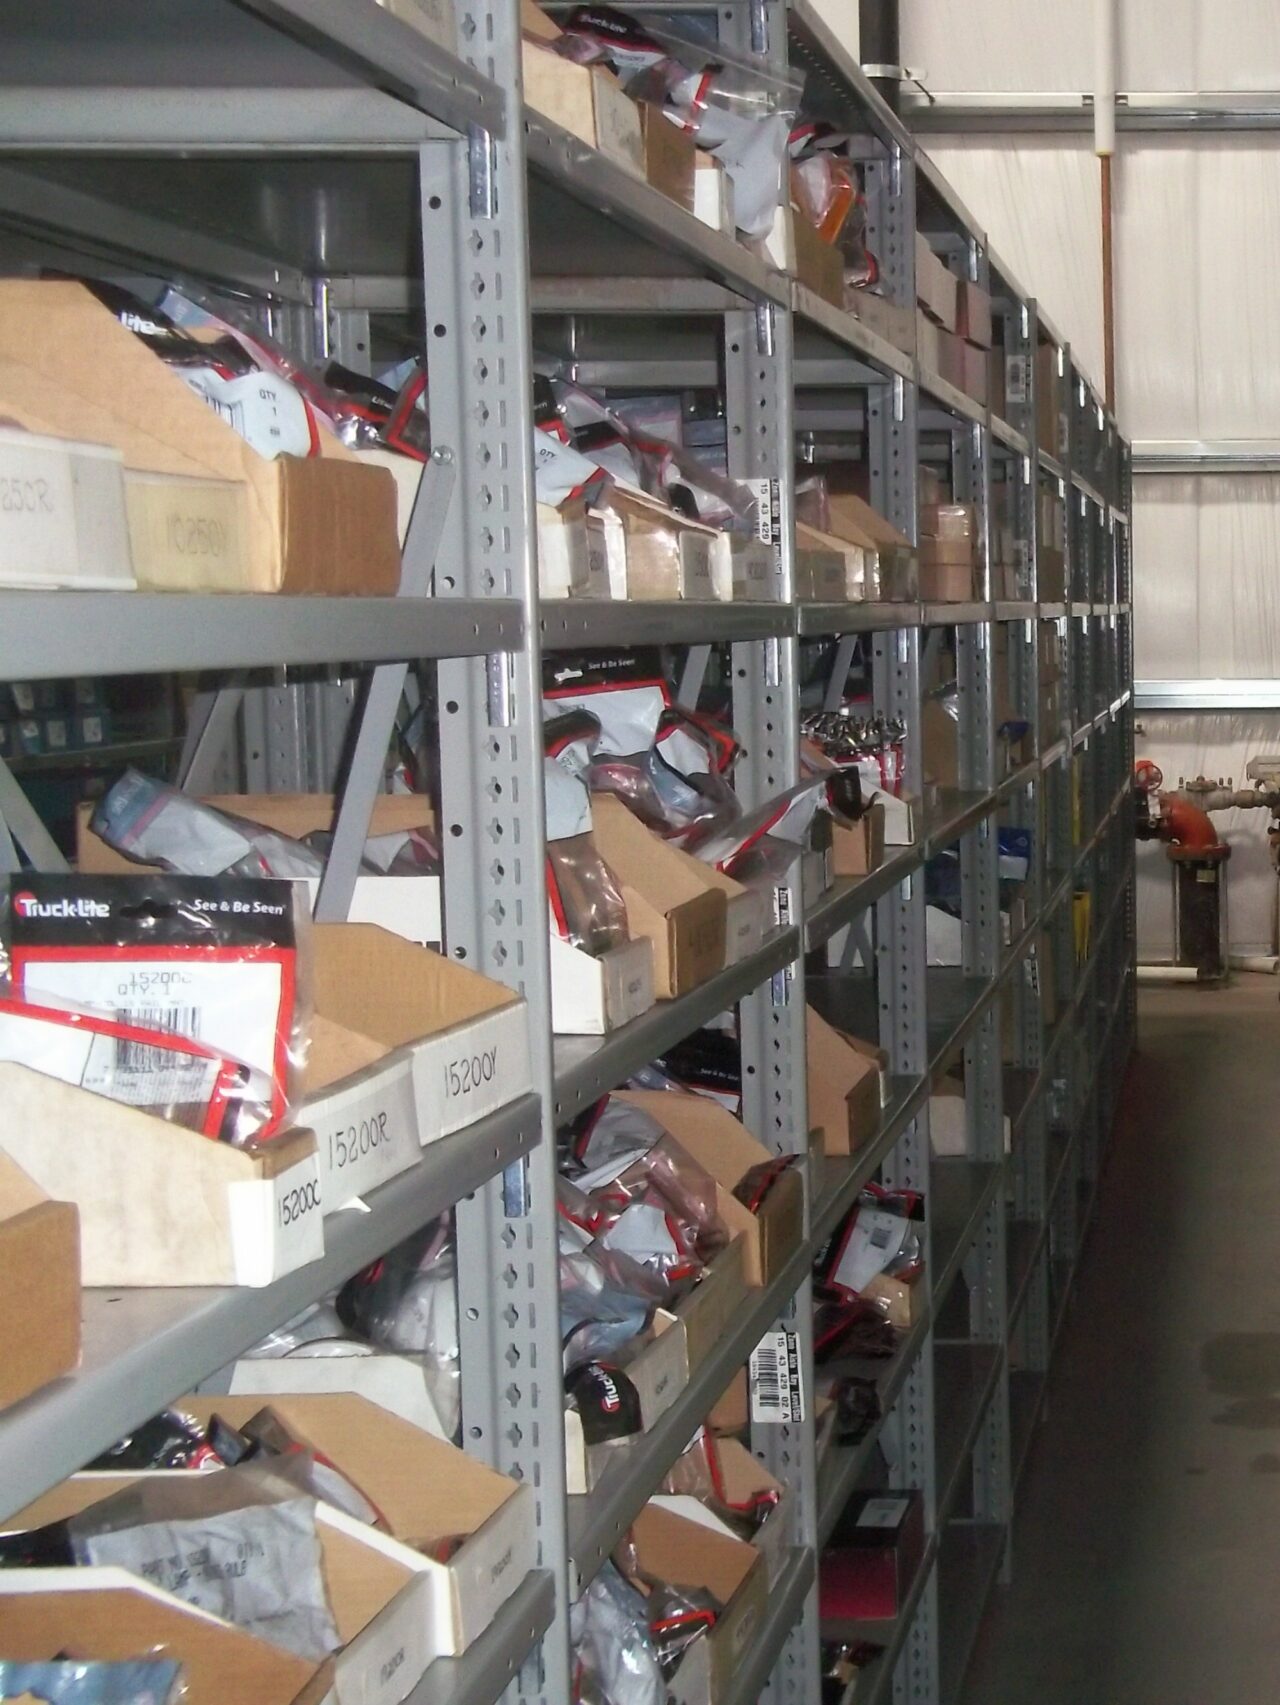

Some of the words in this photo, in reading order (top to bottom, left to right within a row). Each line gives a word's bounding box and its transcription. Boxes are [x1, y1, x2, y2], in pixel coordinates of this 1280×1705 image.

[259, 388, 277, 401] QTY
[760, 482, 769, 495] 15
[761, 502, 769, 515] 43
[762, 521, 770, 541] 429
[20, 898, 110, 918] Truck-Lite
[194, 899, 215, 912] See
[220, 901, 230, 913] &
[233, 901, 250, 913] Be
[253, 901, 284, 916] Seen
[444, 1045, 498, 1099] 15200Y
[328, 1111, 391, 1171] 15200R
[777, 1335, 786, 1348] 15
[778, 1354, 787, 1367] 43
[780, 1372, 788, 1390] 429
[781, 1396, 790, 1408] 02
[782, 1411, 790, 1420] A
